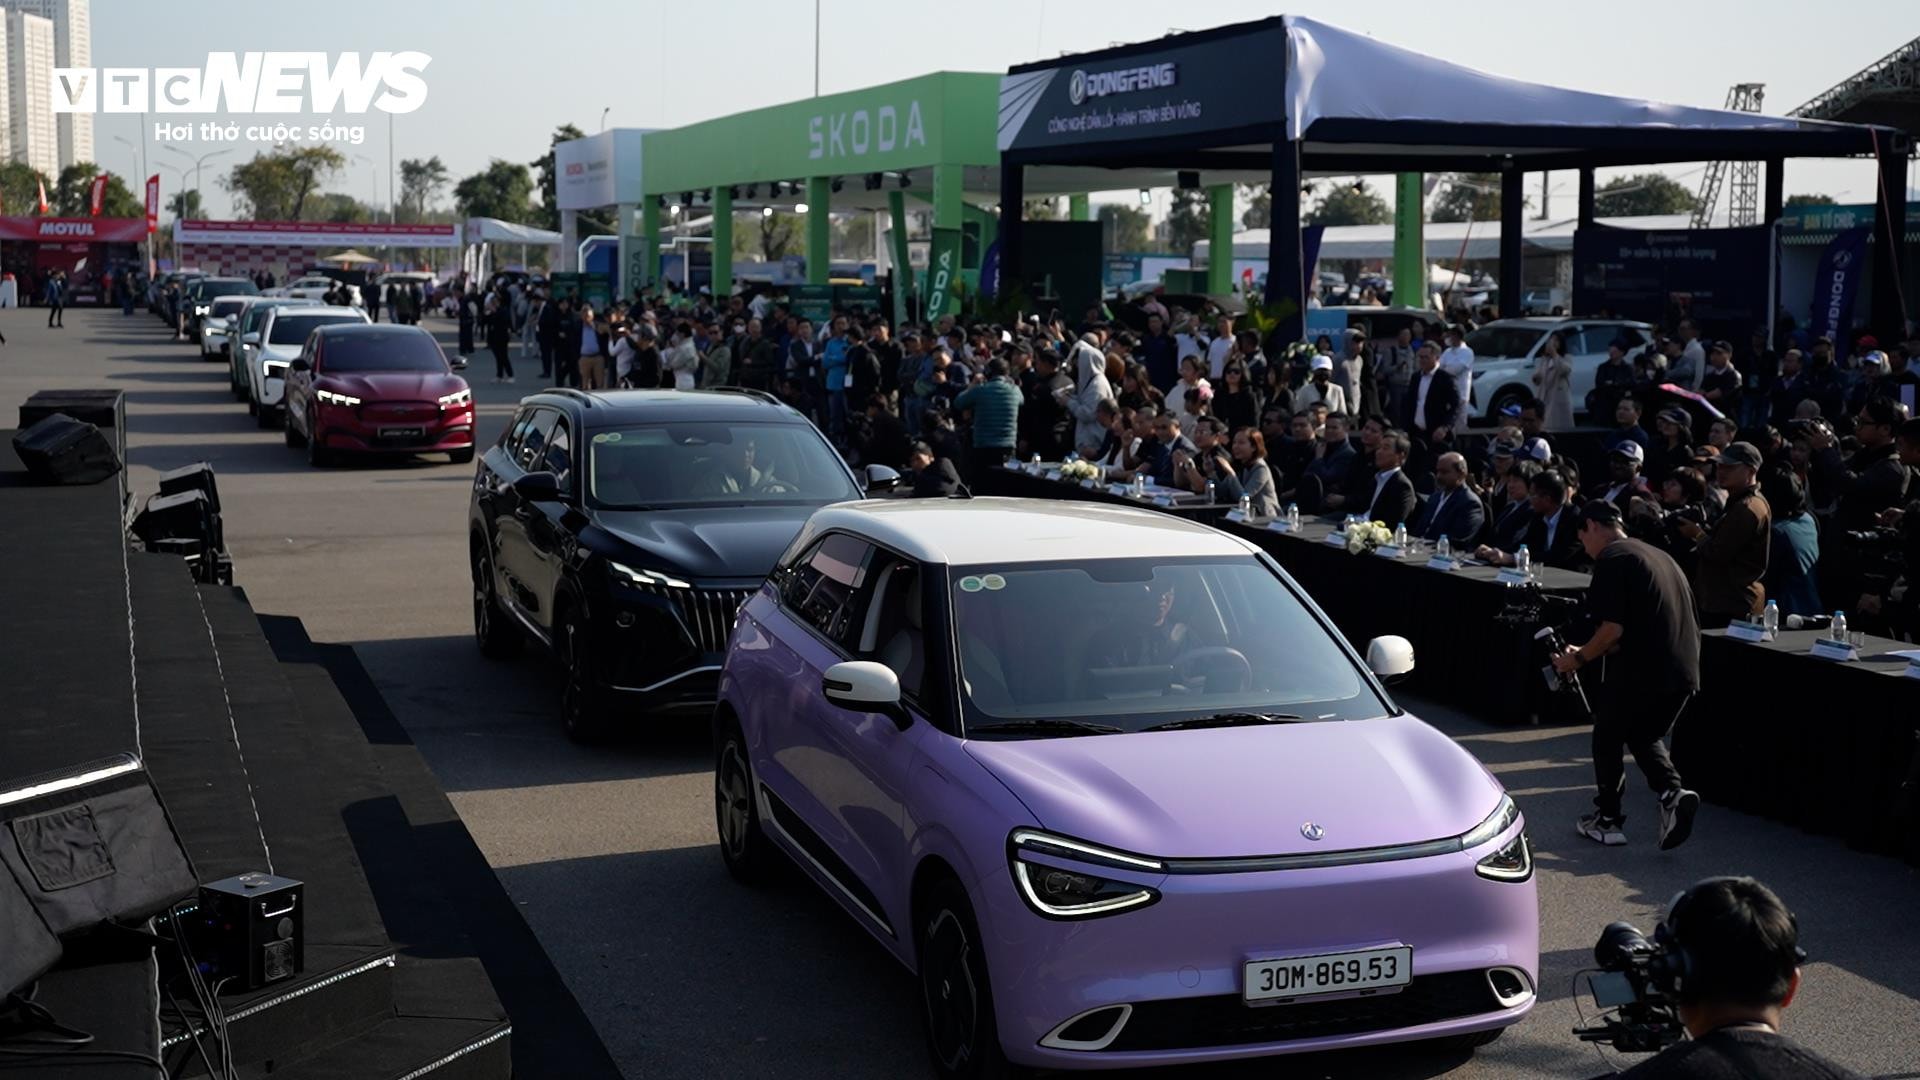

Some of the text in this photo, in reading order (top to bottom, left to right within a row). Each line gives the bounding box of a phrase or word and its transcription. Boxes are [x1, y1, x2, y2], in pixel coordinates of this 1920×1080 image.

[1087, 63, 1175, 96] DONGFENG
[808, 99, 926, 160] SKODA
[39, 222, 96, 236] MOTUL
[630, 250, 642, 289] ODA
[926, 249, 953, 322] KODA
[1825, 270, 1846, 342] DONGFE
[1260, 956, 1397, 991] 30M-869.53
